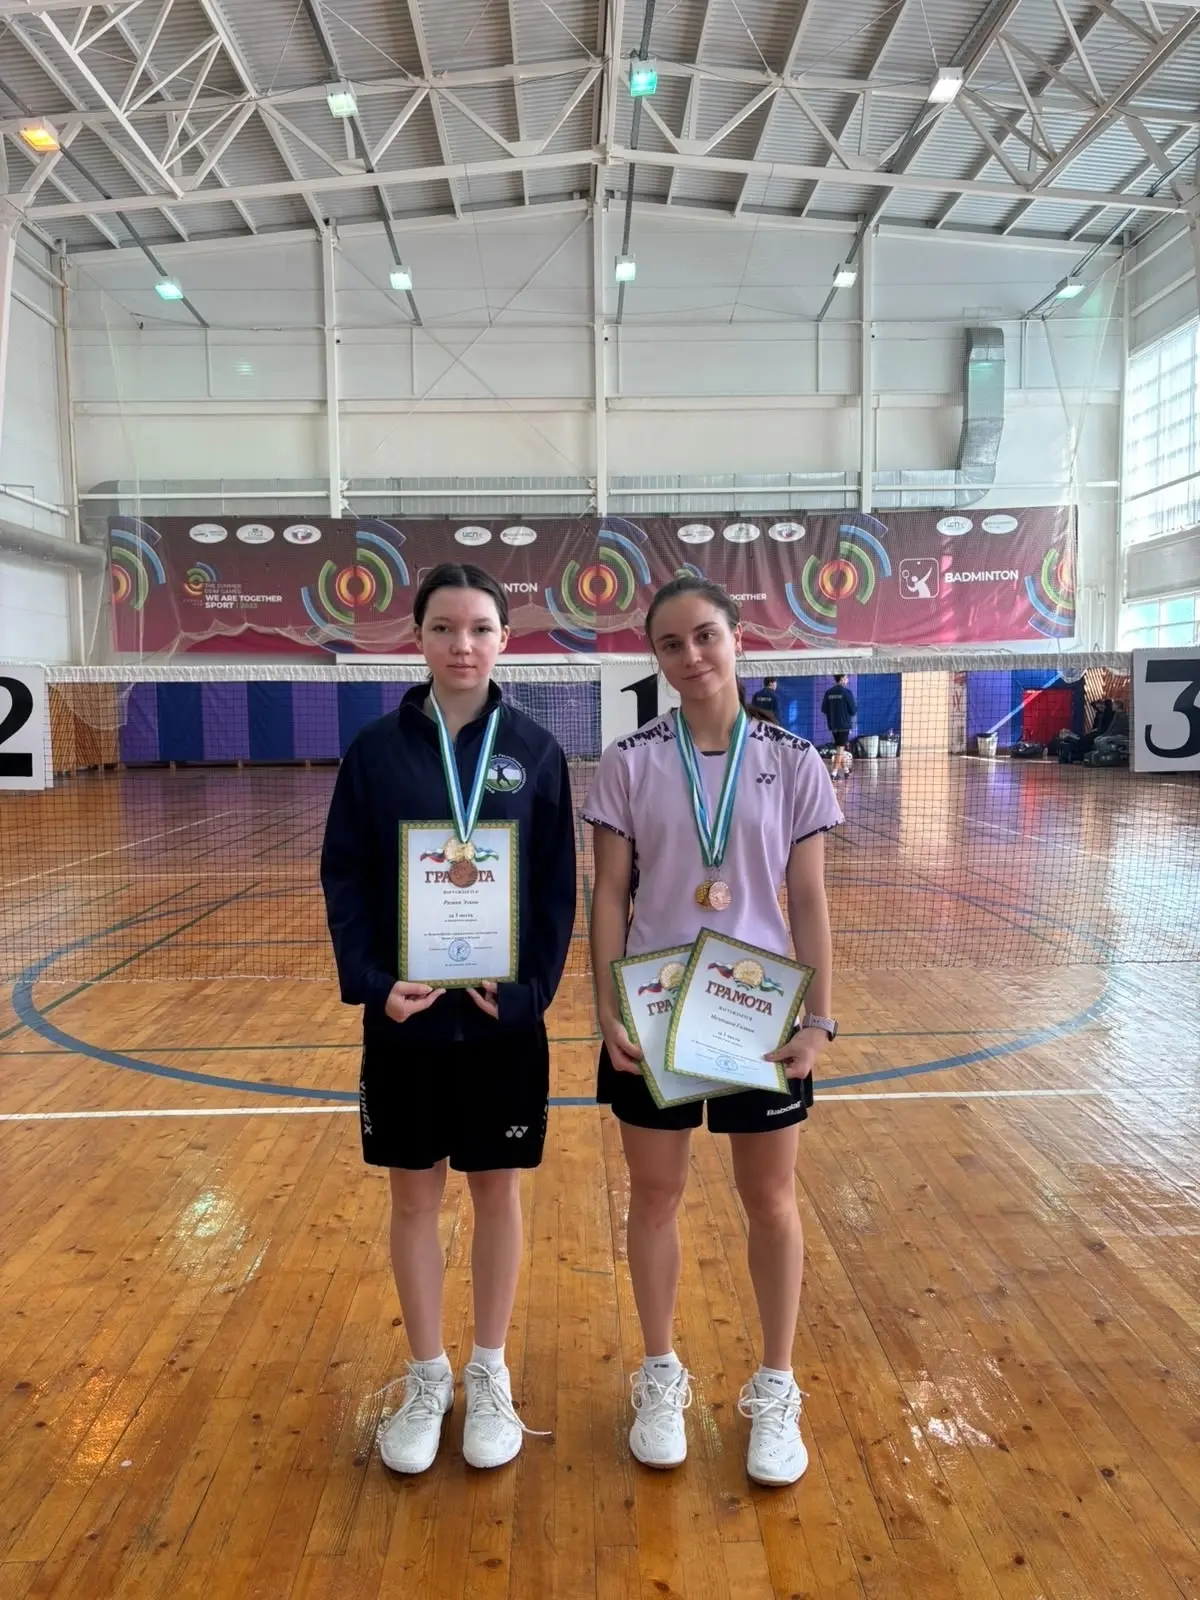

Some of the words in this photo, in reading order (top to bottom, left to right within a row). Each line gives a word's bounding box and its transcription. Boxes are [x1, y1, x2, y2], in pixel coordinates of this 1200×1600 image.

[944, 570, 1019, 583] BADMINTON
[503, 582, 538, 593] NTON
[239, 595, 282, 603] TOGETHER
[729, 593, 767, 601] OGETHER
[1145, 659, 1200, 759] 3
[425, 870, 496, 884] ГРАТА
[705, 980, 773, 1016] ГРАМОТА
[647, 998, 674, 1016] ГРА
